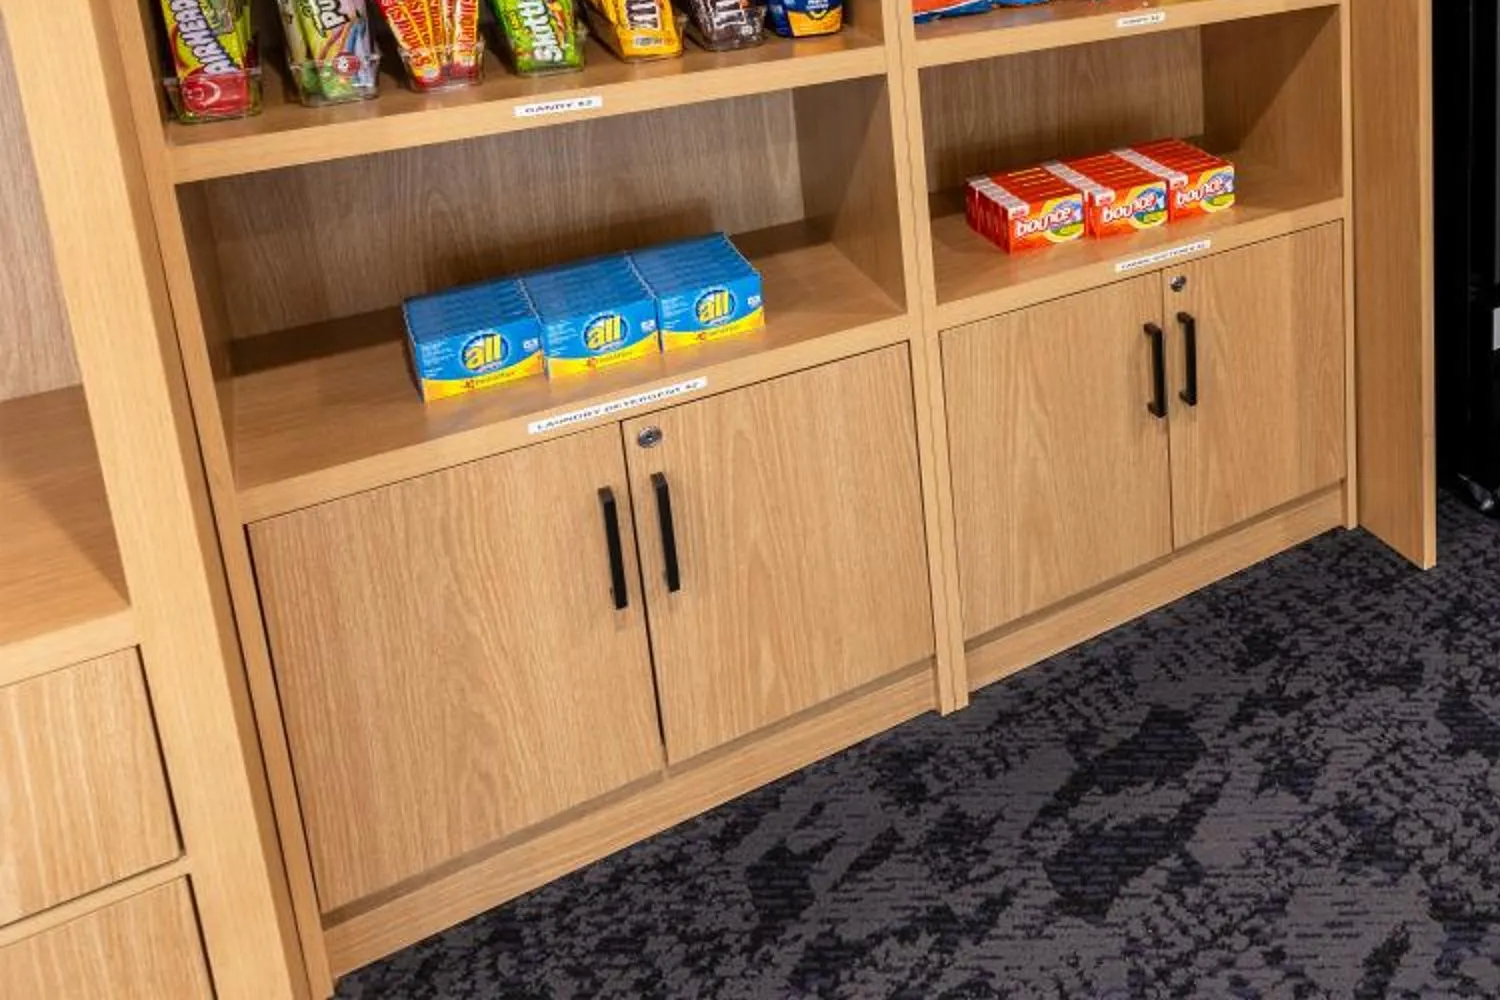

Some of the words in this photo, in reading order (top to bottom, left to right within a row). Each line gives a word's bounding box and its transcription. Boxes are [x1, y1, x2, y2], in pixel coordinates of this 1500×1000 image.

[1103, 190, 1157, 223] bounce
[1175, 177, 1227, 206] bounce
[1014, 206, 1072, 238] bounce
[696, 289, 729, 323] all
[586, 314, 621, 349] all
[462, 333, 501, 370] all
